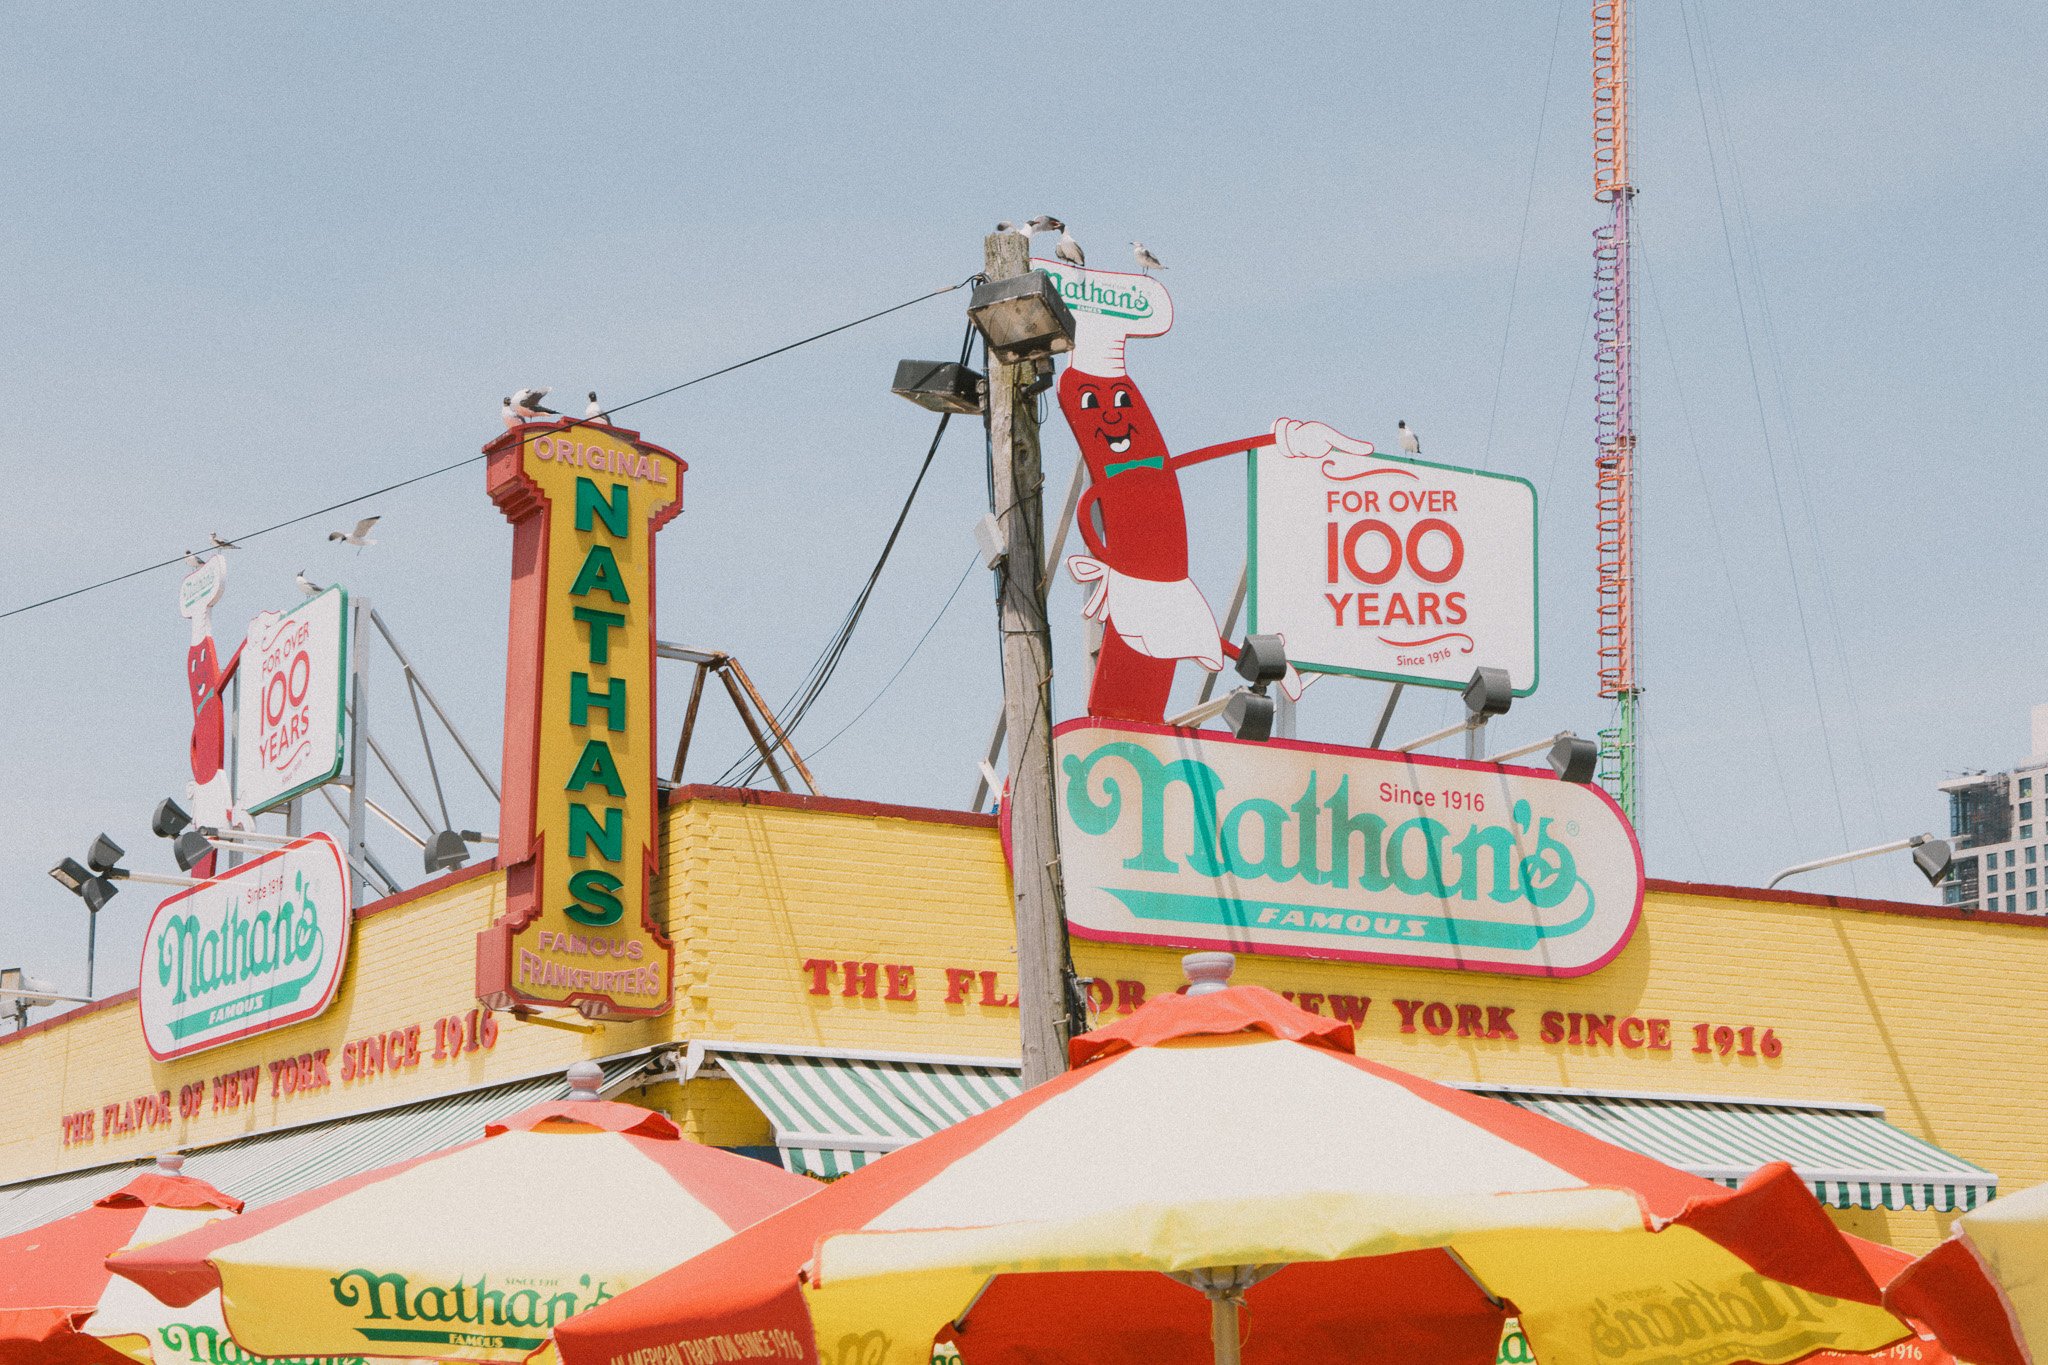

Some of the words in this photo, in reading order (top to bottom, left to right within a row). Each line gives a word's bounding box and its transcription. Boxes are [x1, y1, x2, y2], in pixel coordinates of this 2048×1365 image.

[533, 436, 668, 483] ORIGINAL
[1327, 491, 1380, 513] FOR
[1389, 490, 1458, 512] OVER
[1327, 518, 1464, 585] 100
[1324, 592, 1467, 626] YEARS
[261, 641, 281, 681] FOR
[283, 621, 310, 658] OVER
[1396, 655, 1424, 666] Since
[1428, 649, 1451, 663] 1916
[260, 650, 310, 737] 100
[564, 476, 631, 927] NATHANS
[259, 704, 310, 769] YEARS
[1379, 782, 1436, 807] Since
[1442, 790, 1485, 812] 1916
[1062, 741, 1579, 908] Nathan's
[158, 869, 318, 1006] Nathan's
[538, 931, 643, 960] FAMOUS
[1256, 907, 1430, 937] FAMOUS
[519, 947, 660, 996] FRANKFURTERS
[208, 994, 265, 1026] FAMOUS
[803, 958, 917, 1001] THE
[944, 967, 1146, 1014] FLOR
[1282, 990, 1372, 1030] EW
[1393, 998, 1518, 1040] YORK
[1540, 1011, 1672, 1050] SINCE
[1691, 1023, 1783, 1058] 1916
[62, 1108, 94, 1146] THE
[101, 1090, 171, 1137] FLAVOR
[178, 1080, 205, 1119] OF
[212, 1065, 259, 1112] NEW
[268, 1048, 331, 1098] YORK
[340, 1023, 421, 1083] SINCE
[431, 1008, 499, 1060] 1916
[448, 1333, 504, 1349] FAMOUS
[768, 1328, 804, 1360] 1916
[1890, 1343, 1923, 1361] 1916
